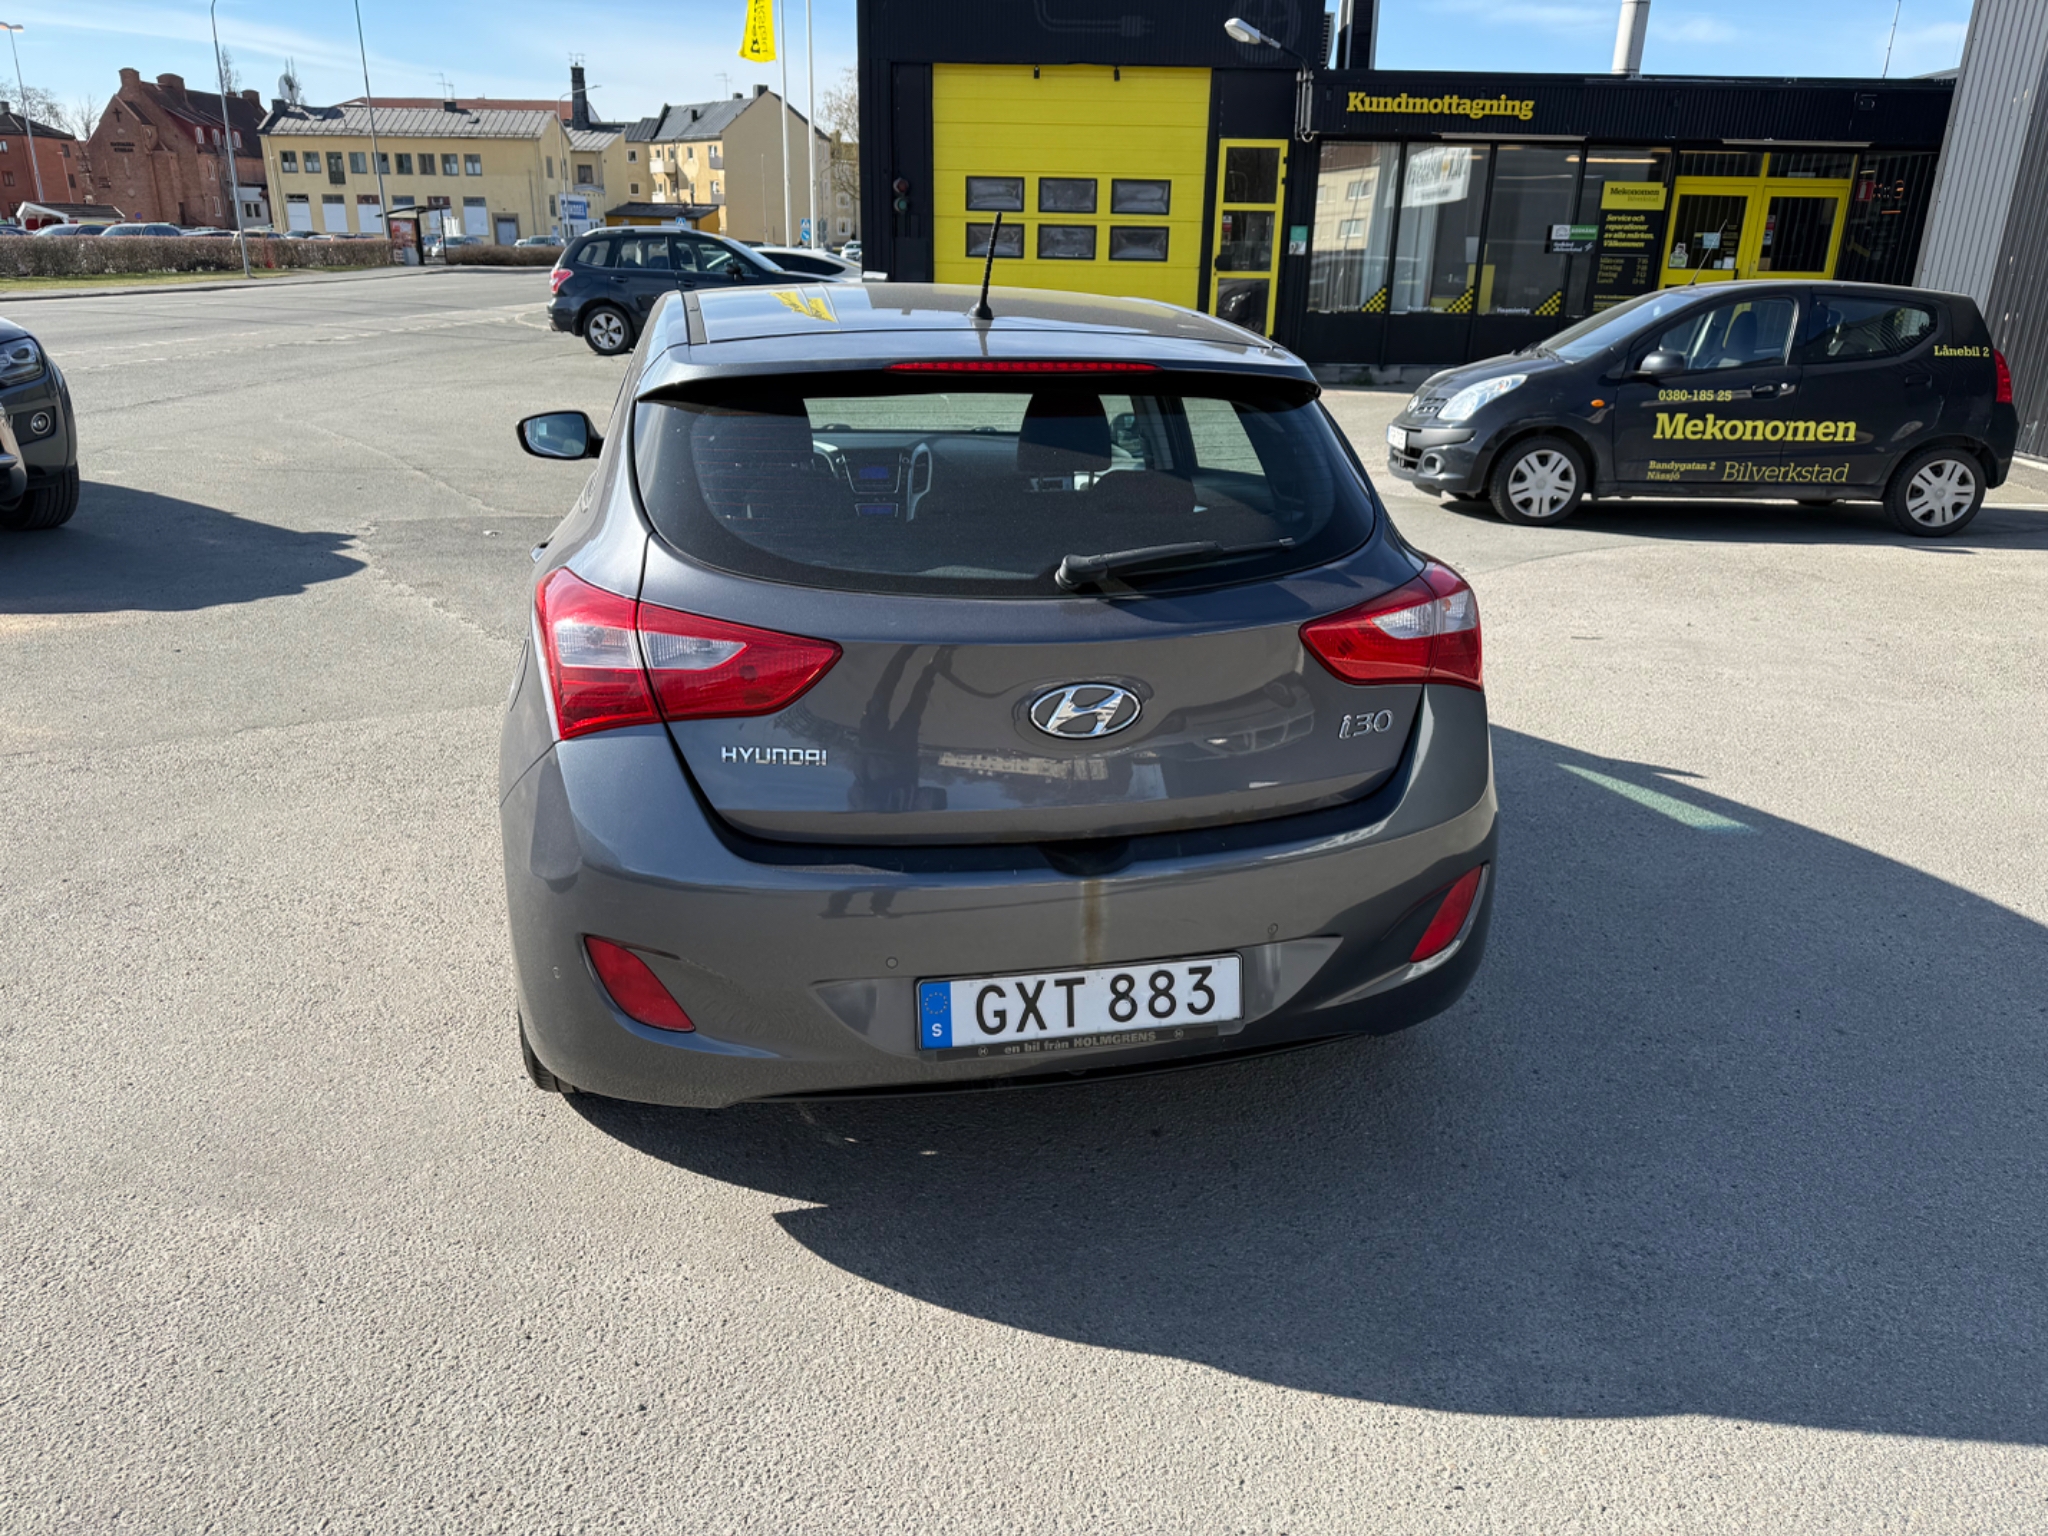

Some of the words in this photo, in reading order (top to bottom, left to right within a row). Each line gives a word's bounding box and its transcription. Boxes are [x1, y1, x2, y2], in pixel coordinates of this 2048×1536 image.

[1347, 91, 1535, 120] Kundmottagning
[1610, 187, 1660, 195] Mekonomen
[1606, 213, 1631, 222] Service
[1631, 214, 1646, 222] och
[1933, 343, 1981, 357] Lånebil
[1982, 346, 1990, 358] 2
[1658, 389, 1714, 402] 0380-185
[1716, 390, 1733, 402] 25
[1652, 412, 1857, 442] Mekonomen
[1648, 460, 1707, 472] Bandygatan
[1708, 461, 1717, 471] 2
[1721, 461, 1850, 483] Bilverkstad
[1646, 471, 1681, 482] Nässjö
[1339, 709, 1393, 740] i30
[721, 746, 827, 767] HYUNDAI
[975, 976, 1086, 1036] GXT
[1108, 965, 1216, 1024] 883
[930, 1022, 943, 1038] S
[1004, 1045, 1021, 1055] en
[1024, 1041, 1041, 1053] bil
[1044, 1039, 1070, 1051] från
[1073, 1030, 1156, 1049] HOLMGRENS
